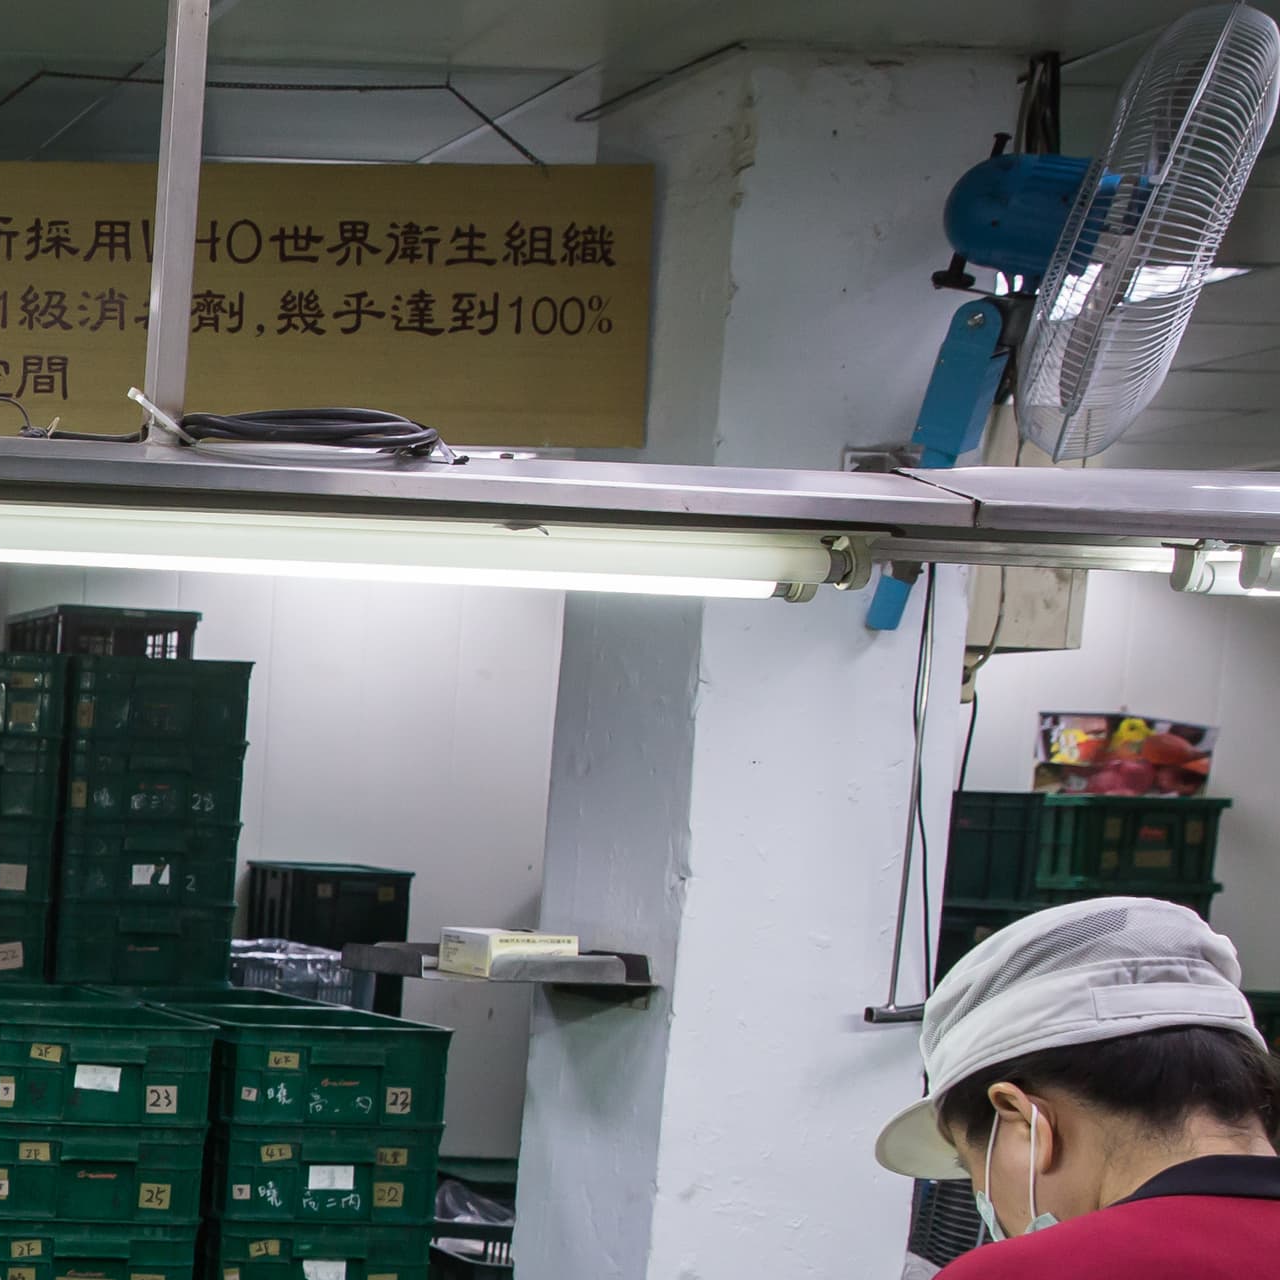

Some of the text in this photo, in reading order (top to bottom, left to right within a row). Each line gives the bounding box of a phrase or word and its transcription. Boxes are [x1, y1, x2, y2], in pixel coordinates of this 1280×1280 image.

[149, 1088, 172, 1108] 23
[388, 1091, 409, 1112] 23
[144, 1187, 166, 1206] 25
